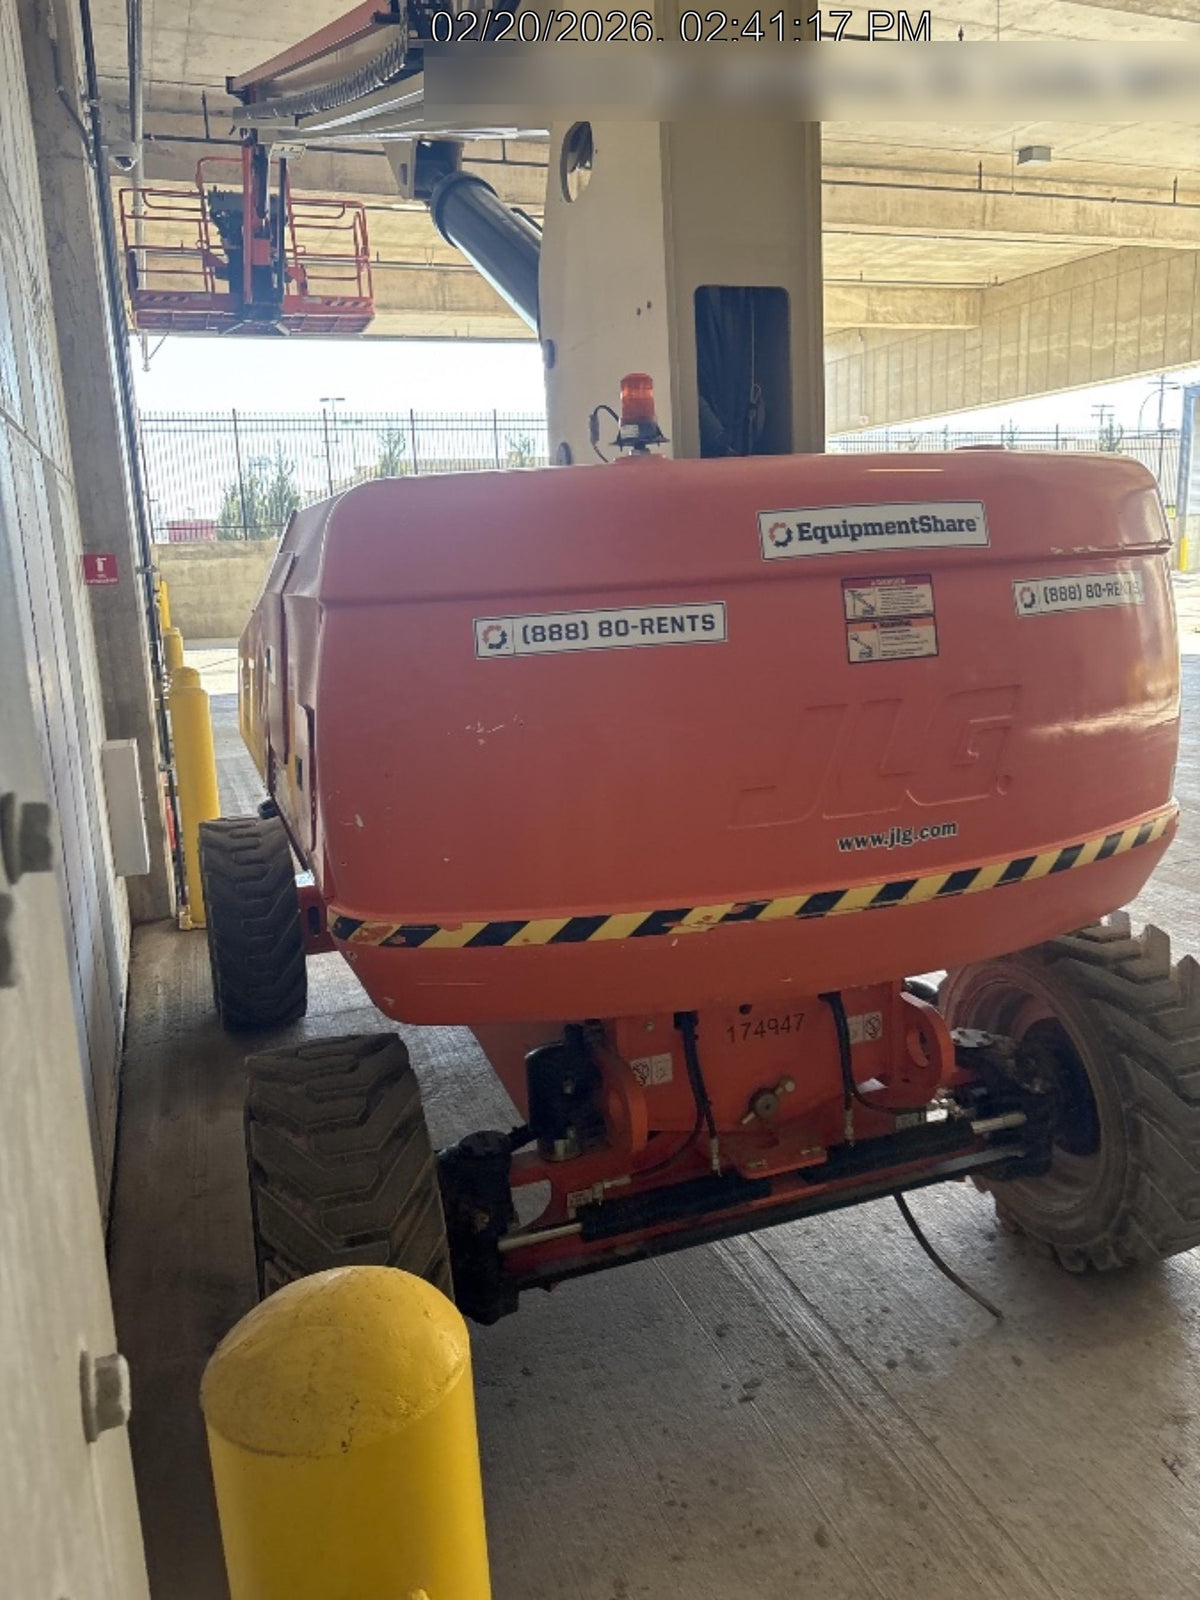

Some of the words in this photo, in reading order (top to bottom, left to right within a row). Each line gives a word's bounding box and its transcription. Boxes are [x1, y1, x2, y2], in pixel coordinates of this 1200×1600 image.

[797, 515, 977, 544] EquipmentShare
[1043, 583, 1083, 605] (888)
[522, 620, 589, 645] (888)
[599, 613, 716, 638] 80-RENTS
[837, 821, 960, 852] www.jlg.com
[726, 1012, 805, 1044] 174947
